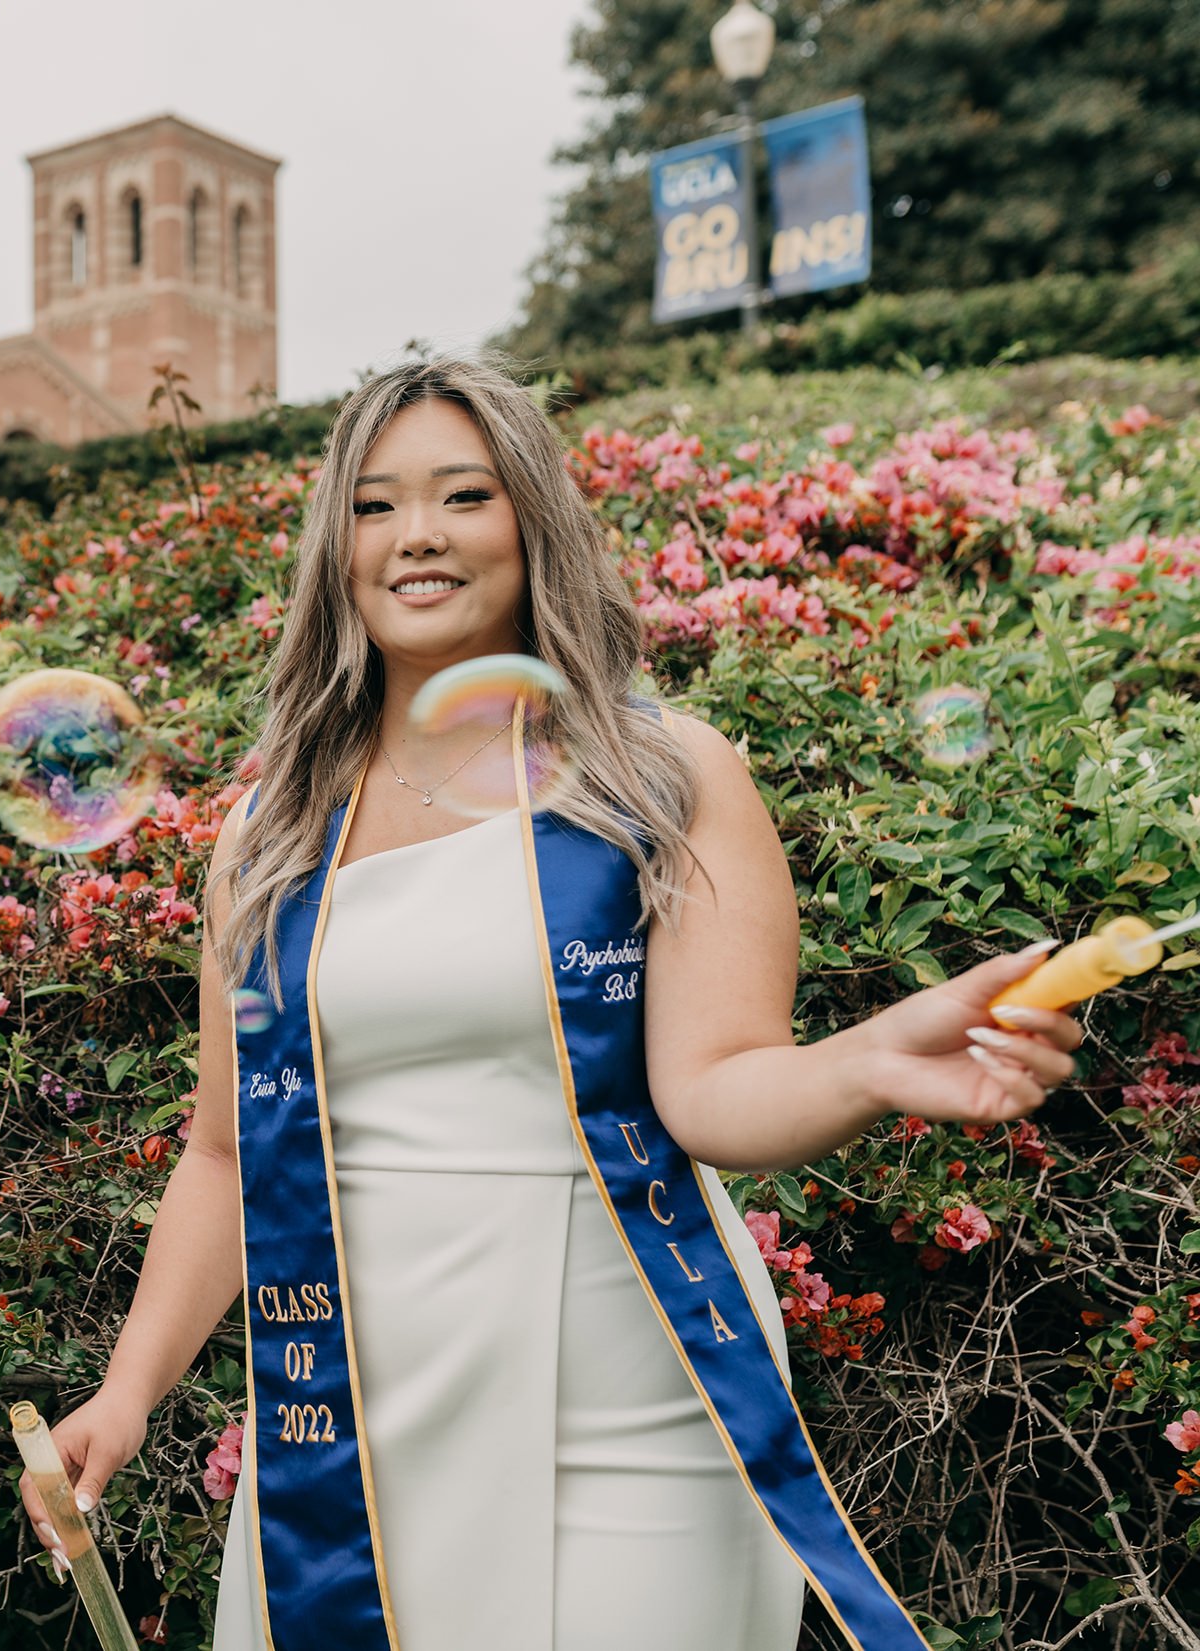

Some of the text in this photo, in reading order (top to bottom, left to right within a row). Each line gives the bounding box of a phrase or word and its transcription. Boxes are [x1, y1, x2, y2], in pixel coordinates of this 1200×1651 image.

[663, 204, 739, 259] GO
[250, 1067, 302, 1101] Erica Yu
[257, 1283, 333, 1323] CLASS
[284, 1341, 316, 1382] OF
[277, 1403, 335, 1445] 2022
